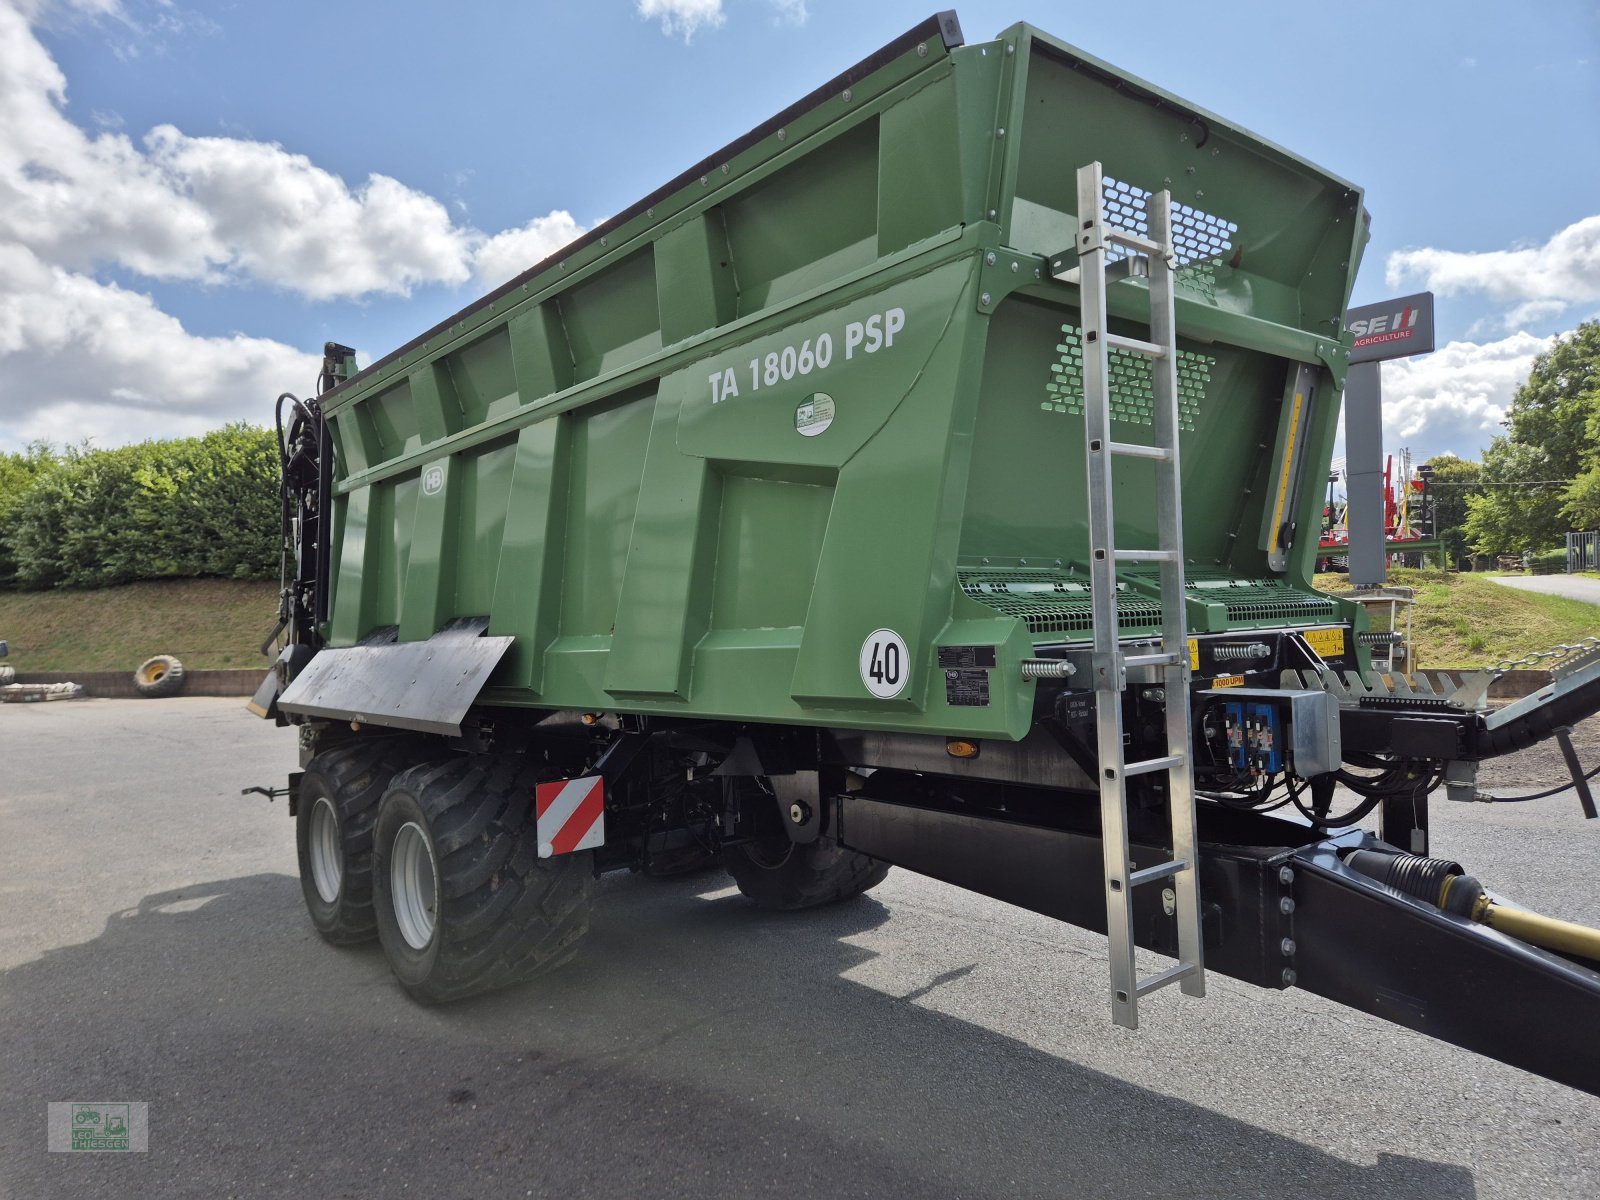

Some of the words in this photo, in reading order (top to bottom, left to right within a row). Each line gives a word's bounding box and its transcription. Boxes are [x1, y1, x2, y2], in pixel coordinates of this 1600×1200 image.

[1344, 315, 1389, 338] SE
[1353, 330, 1412, 347] AGRICULTURE
[708, 368, 740, 405] TA
[749, 332, 833, 392] 18060
[844, 307, 906, 361] PSP
[869, 642, 900, 685] 40
